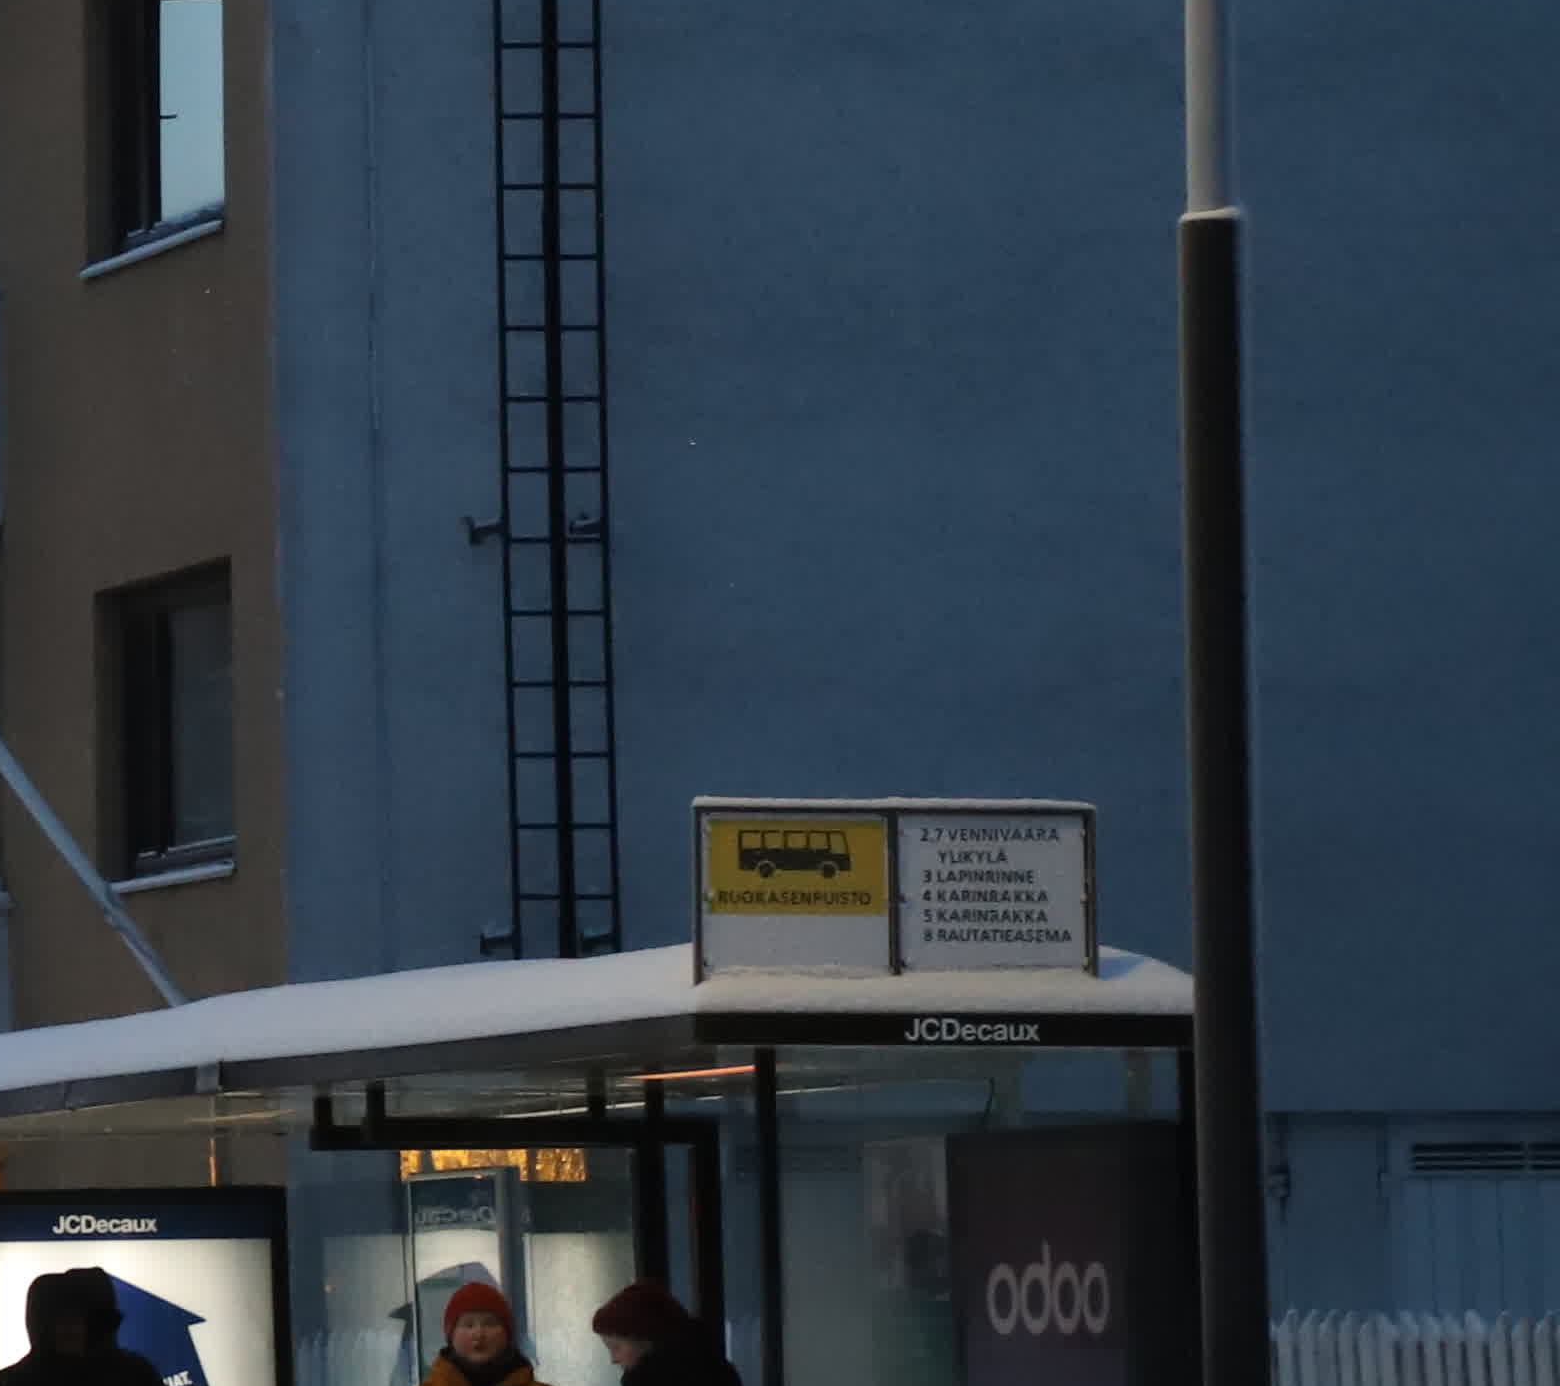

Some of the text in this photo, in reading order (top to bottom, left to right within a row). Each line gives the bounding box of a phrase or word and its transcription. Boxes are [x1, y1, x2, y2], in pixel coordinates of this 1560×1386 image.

[947, 827, 1060, 842] VENNIVAARA
[922, 870, 1035, 884] 3 LAPINRINNE
[717, 890, 872, 906] RUOKASENPUISTO
[922, 890, 1049, 903] 4 KARINRAKKA
[922, 909, 1049, 923] 5 KARINRAKKA
[937, 929, 1073, 942] RAUTATIEASEMA
[905, 1018, 1040, 1043] JCDecaux
[52, 1215, 158, 1234] JCDecaux
[986, 1241, 1110, 1336] odoo
